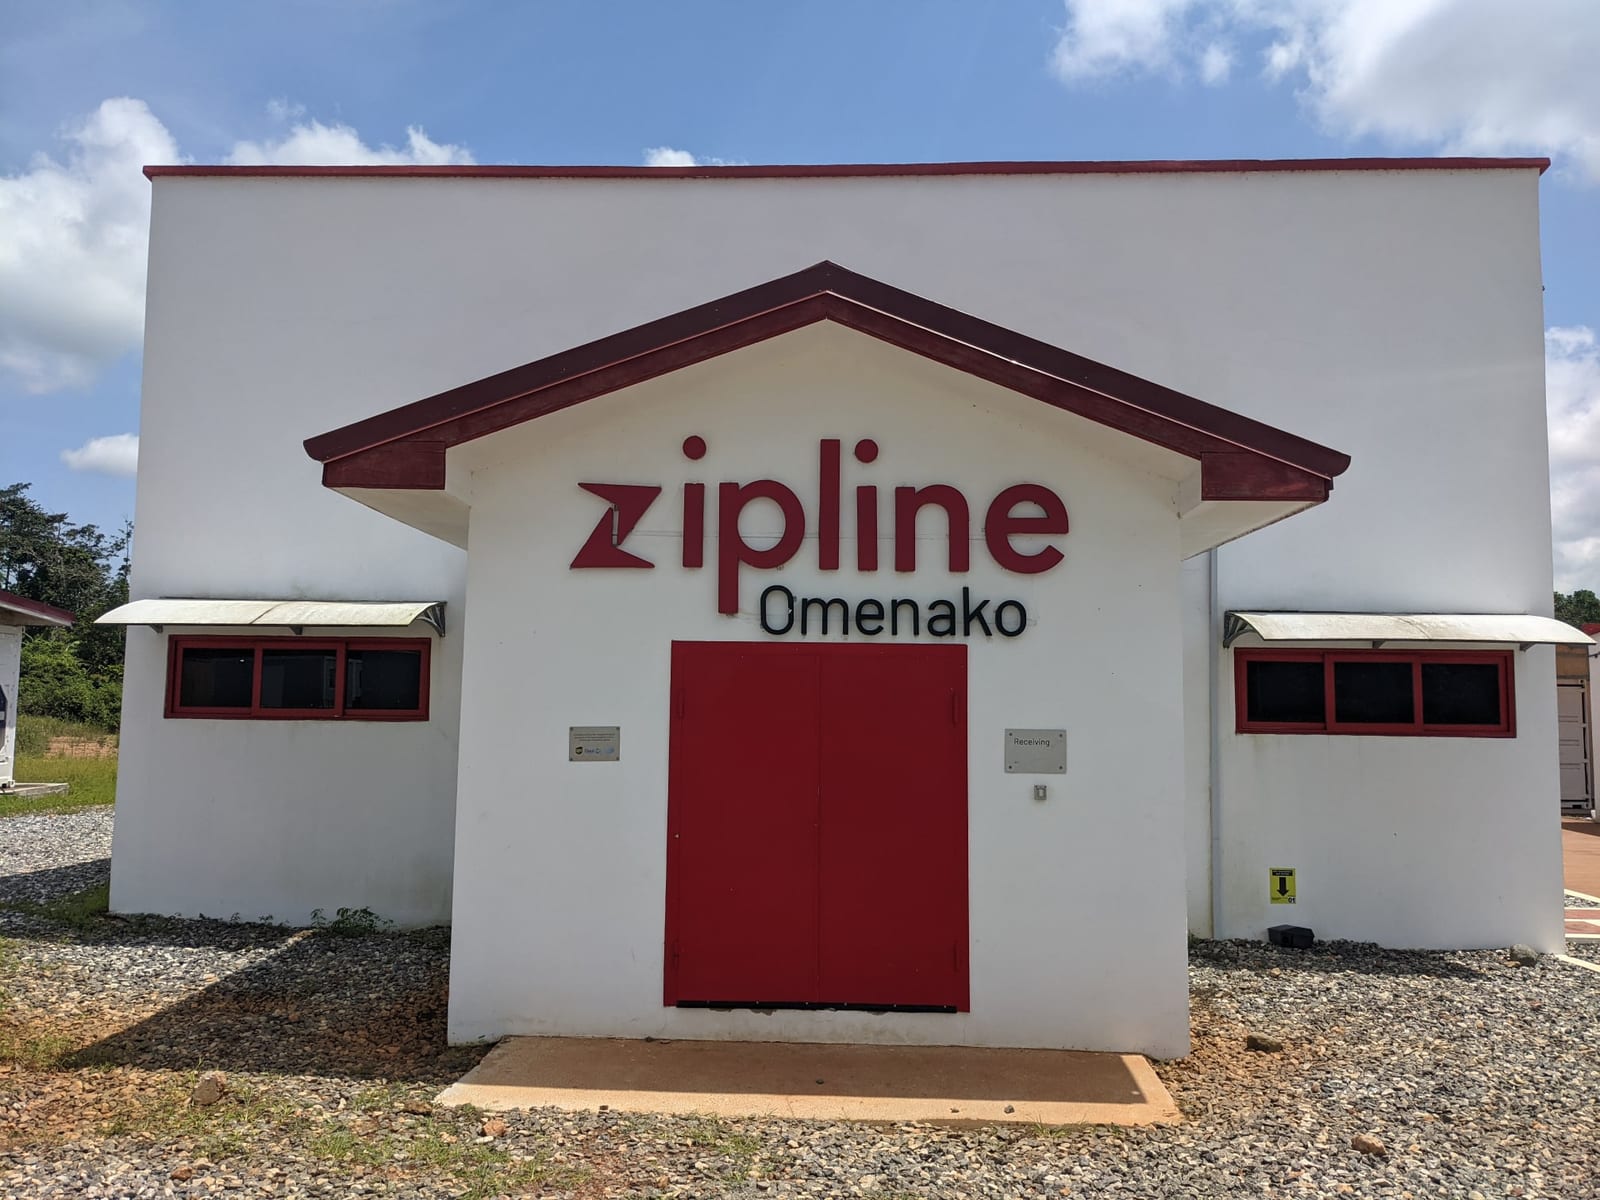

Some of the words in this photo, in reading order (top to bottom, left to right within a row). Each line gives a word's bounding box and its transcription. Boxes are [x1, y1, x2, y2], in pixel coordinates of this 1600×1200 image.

[571, 436, 1069, 614] zipline
[760, 585, 1027, 637] Omenako
[1014, 738, 1050, 747] Receiving
